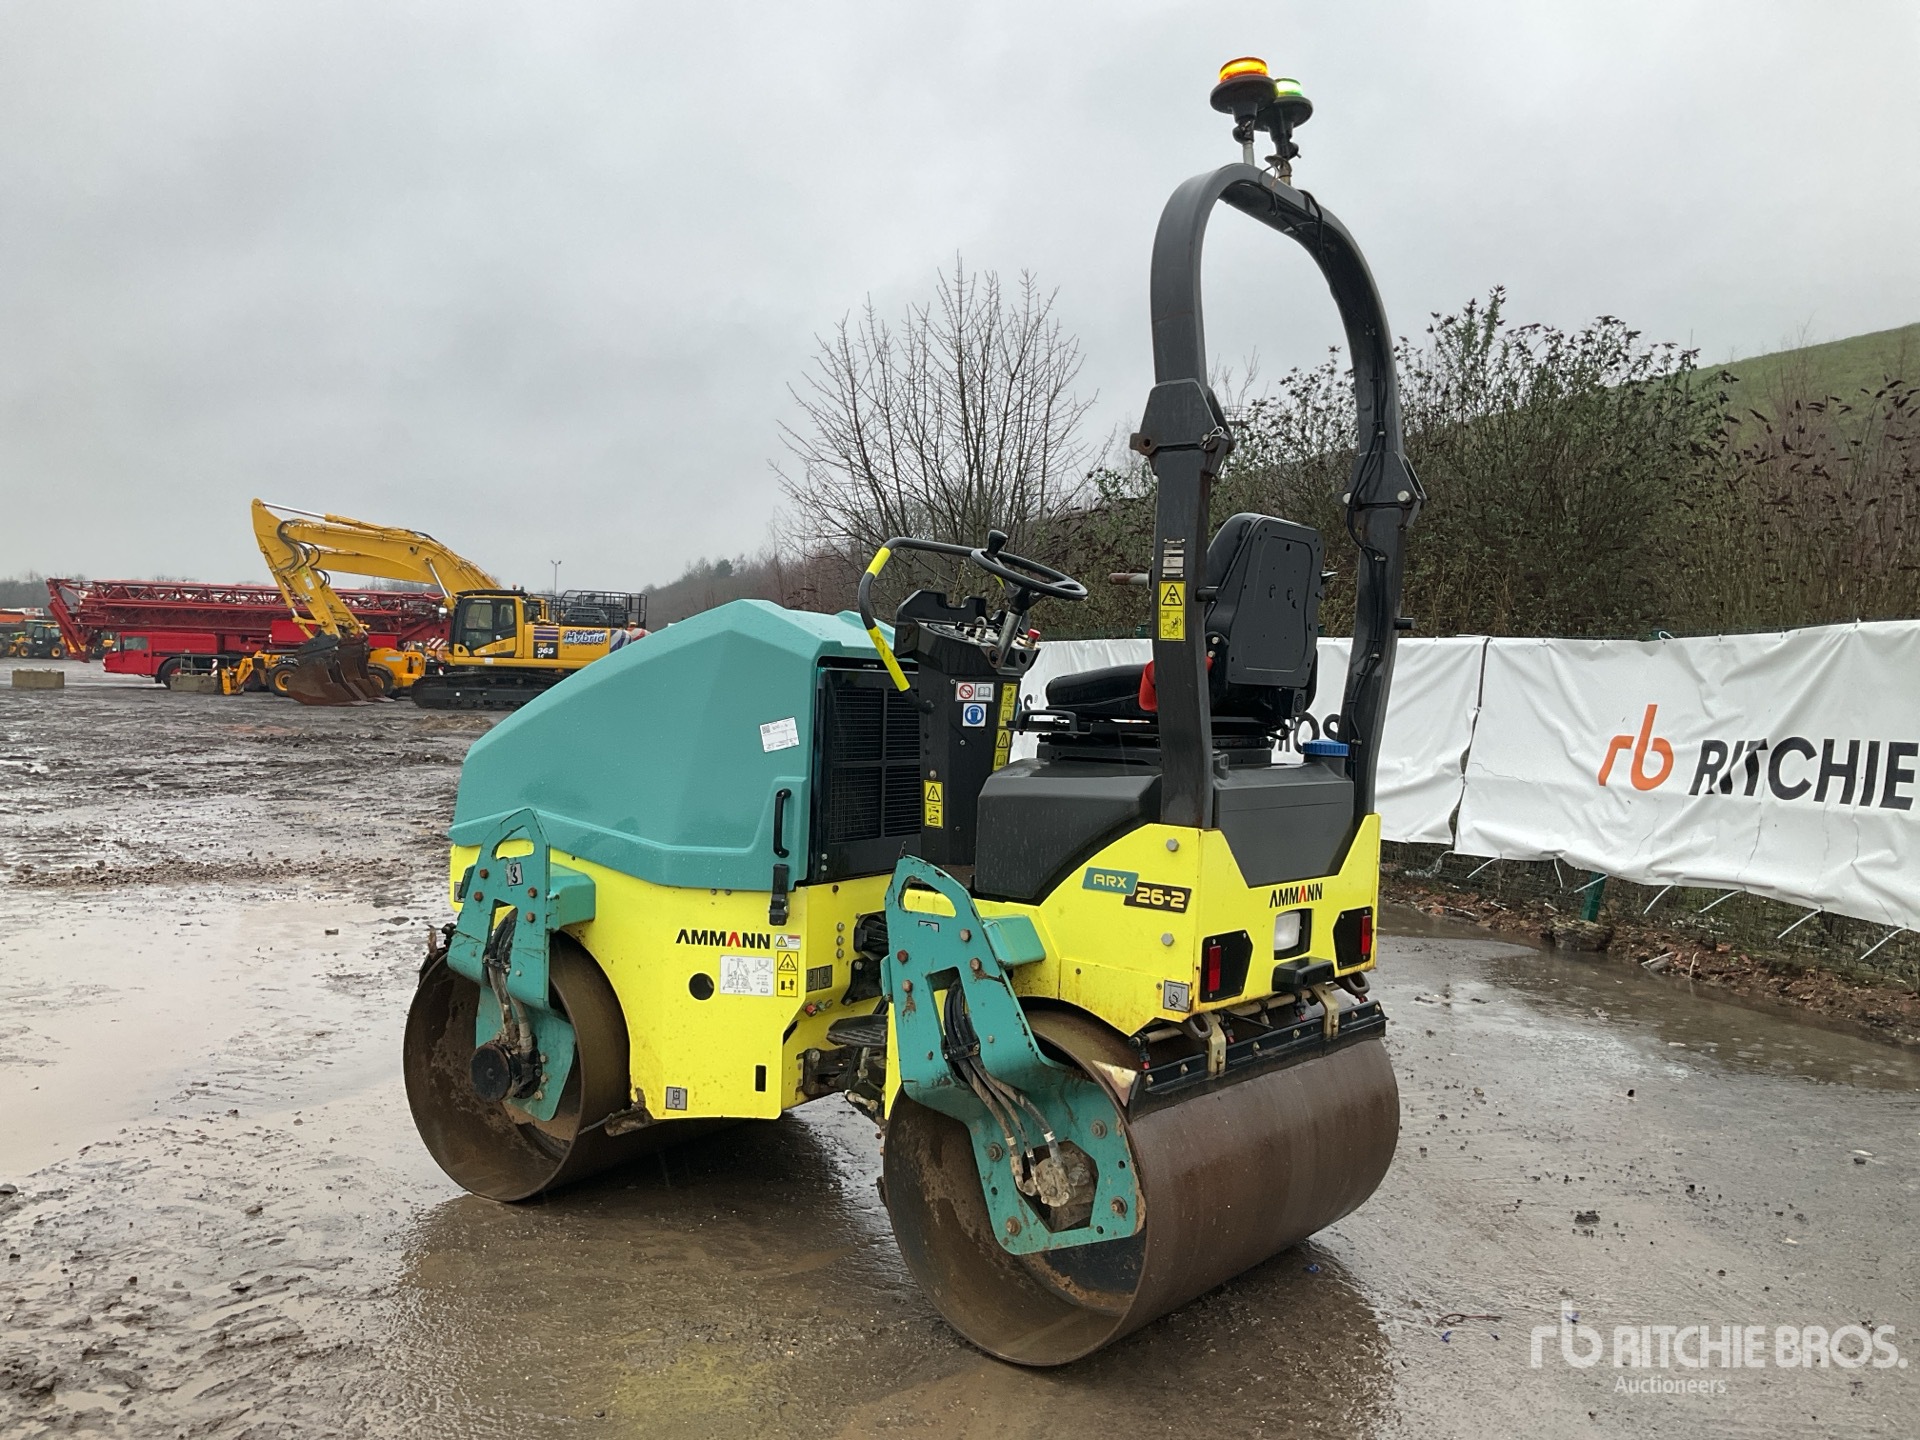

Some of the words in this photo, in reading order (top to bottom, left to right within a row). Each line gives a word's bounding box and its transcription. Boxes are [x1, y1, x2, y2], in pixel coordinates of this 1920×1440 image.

[565, 631, 606, 644] Hybrid
[537, 647, 554, 655] 365
[1688, 736, 1919, 811] RITCHIE
[1093, 873, 1128, 889] ARX
[1135, 886, 1186, 909] 26-2
[1269, 882, 1324, 909] AMMANN
[675, 928, 771, 950] AMMANN
